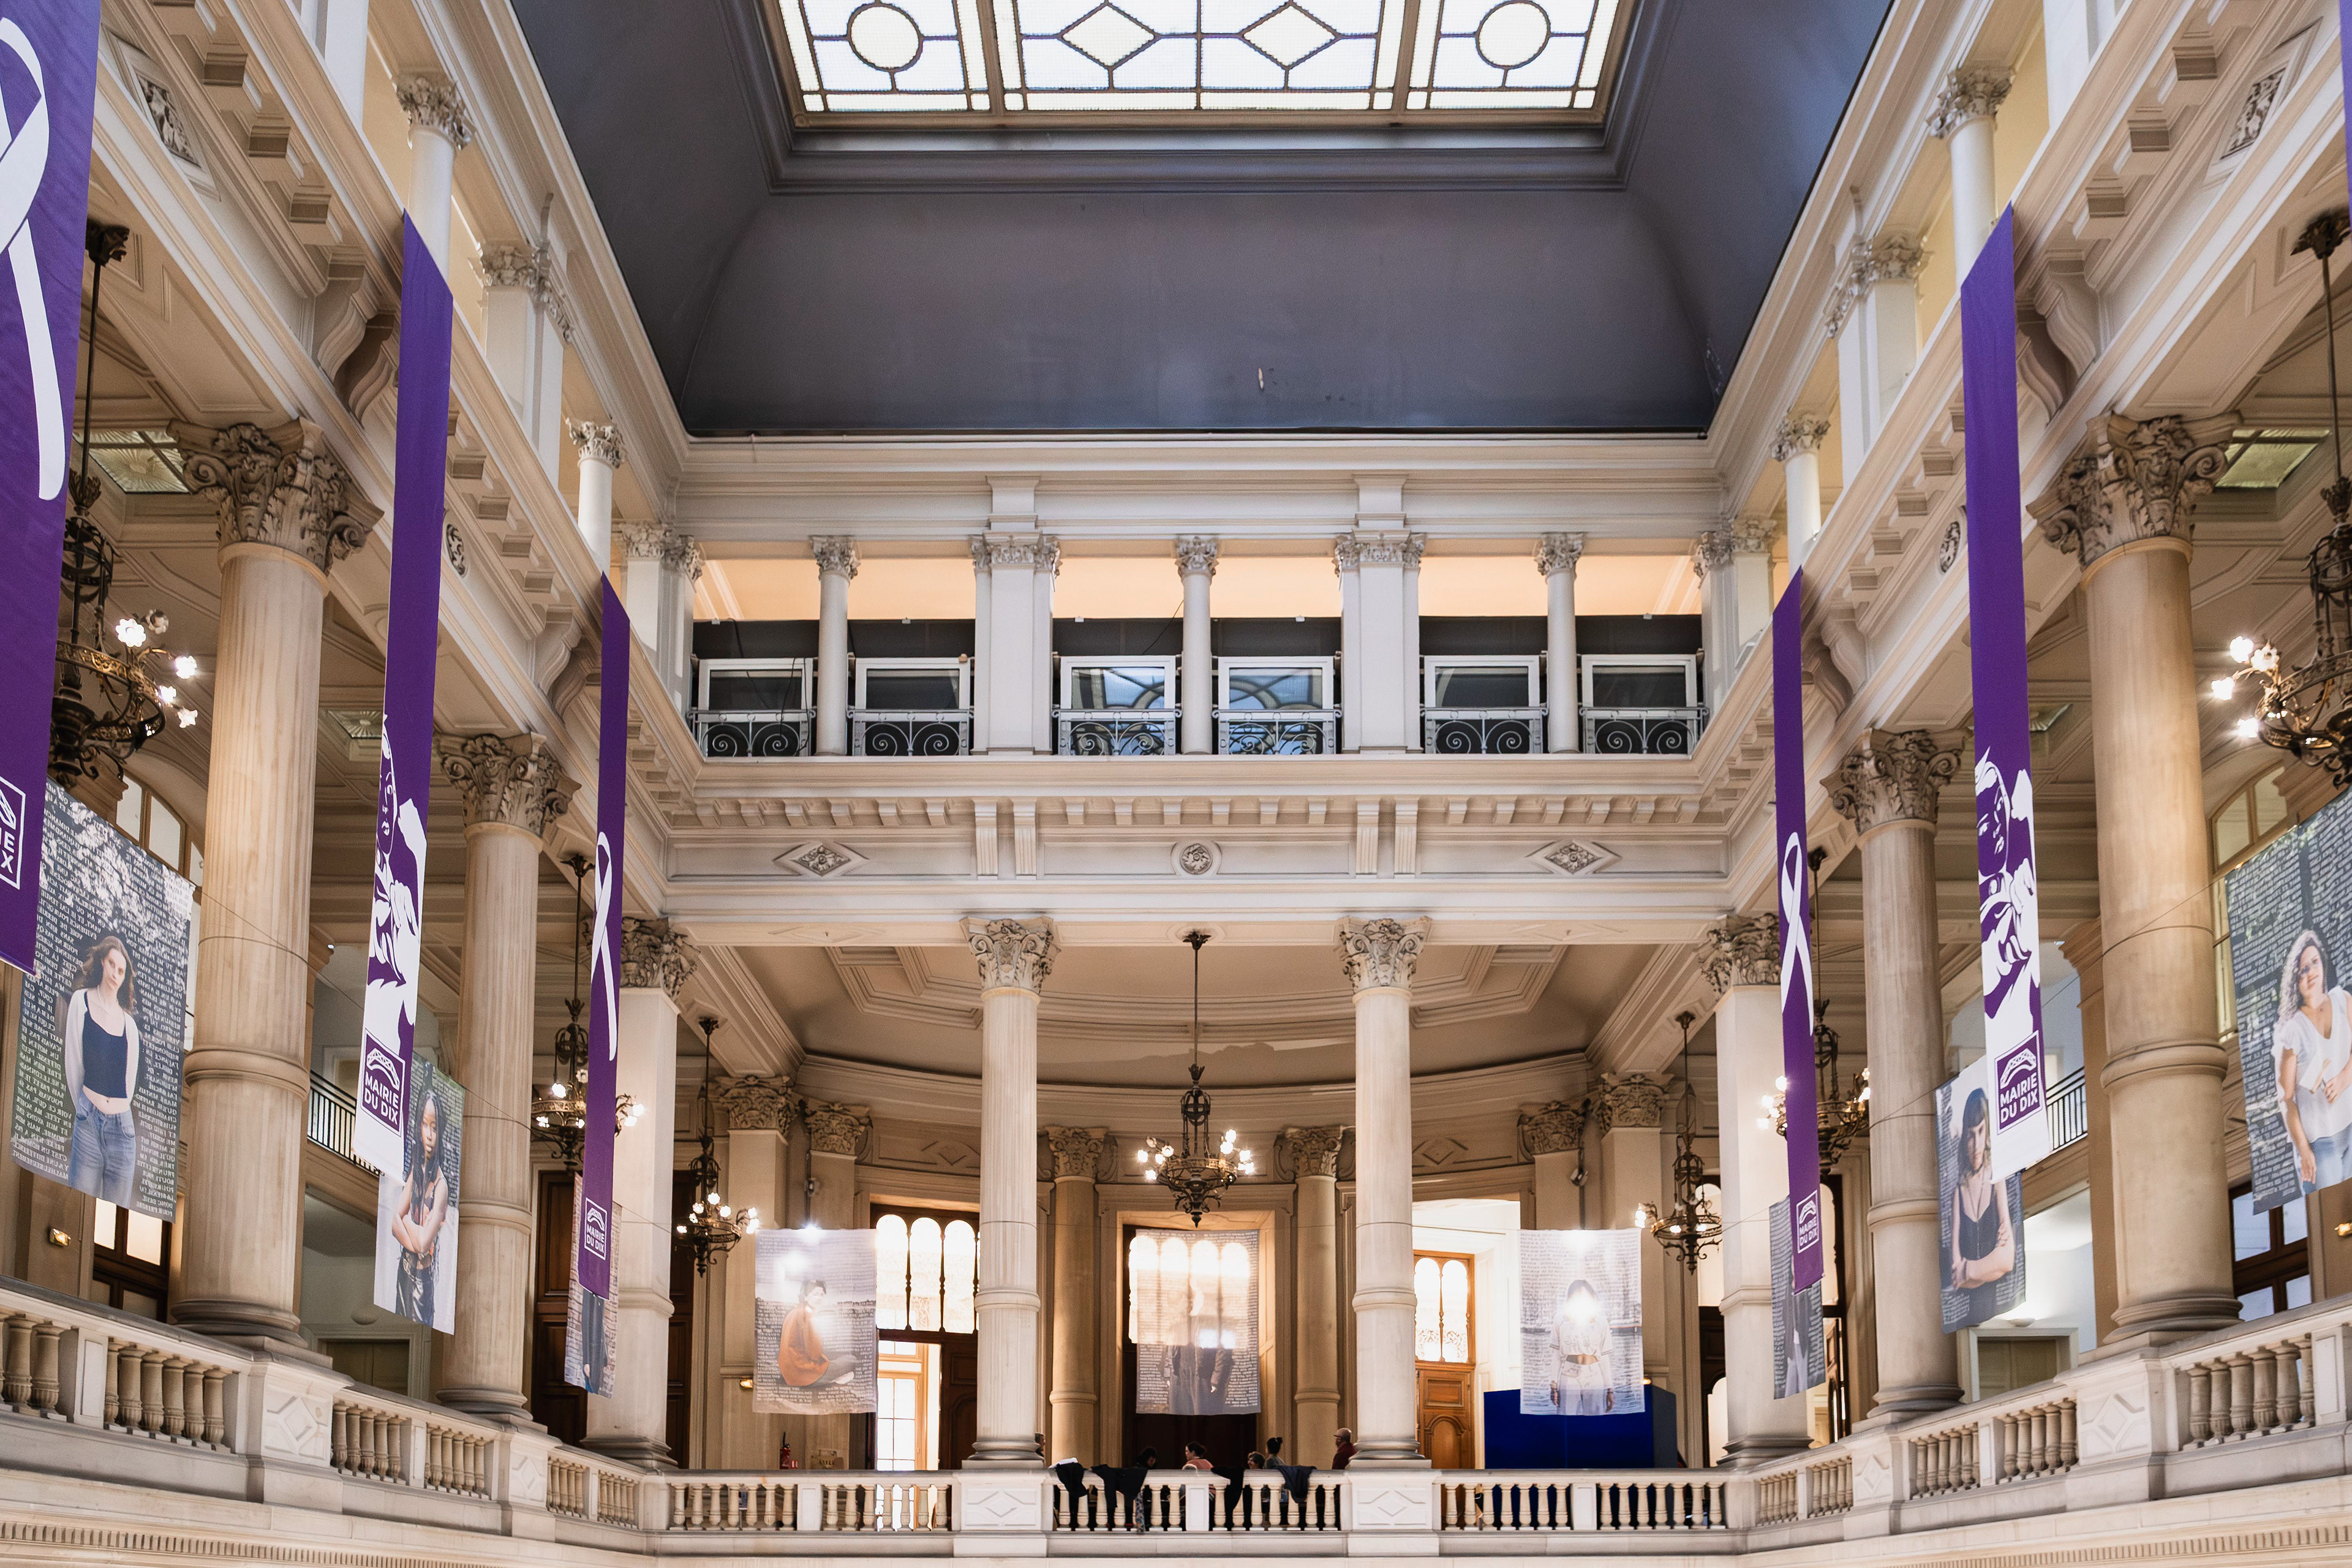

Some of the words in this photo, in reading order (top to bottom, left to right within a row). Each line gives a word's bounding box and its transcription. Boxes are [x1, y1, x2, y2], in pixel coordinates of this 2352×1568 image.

[364, 1088, 378, 1110] DU
[381, 1100, 398, 1125] DIX
[365, 1071, 399, 1109] MAIRIE
[2000, 1072, 2037, 1107] MAIRIE
[2001, 1102, 2017, 1123] DU
[2020, 1088, 2038, 1112] DIX
[587, 1224, 605, 1243] MAIRIE
[587, 1234, 594, 1247] DU
[595, 1240, 604, 1253] DIX
[1800, 1233, 1808, 1246] DU
